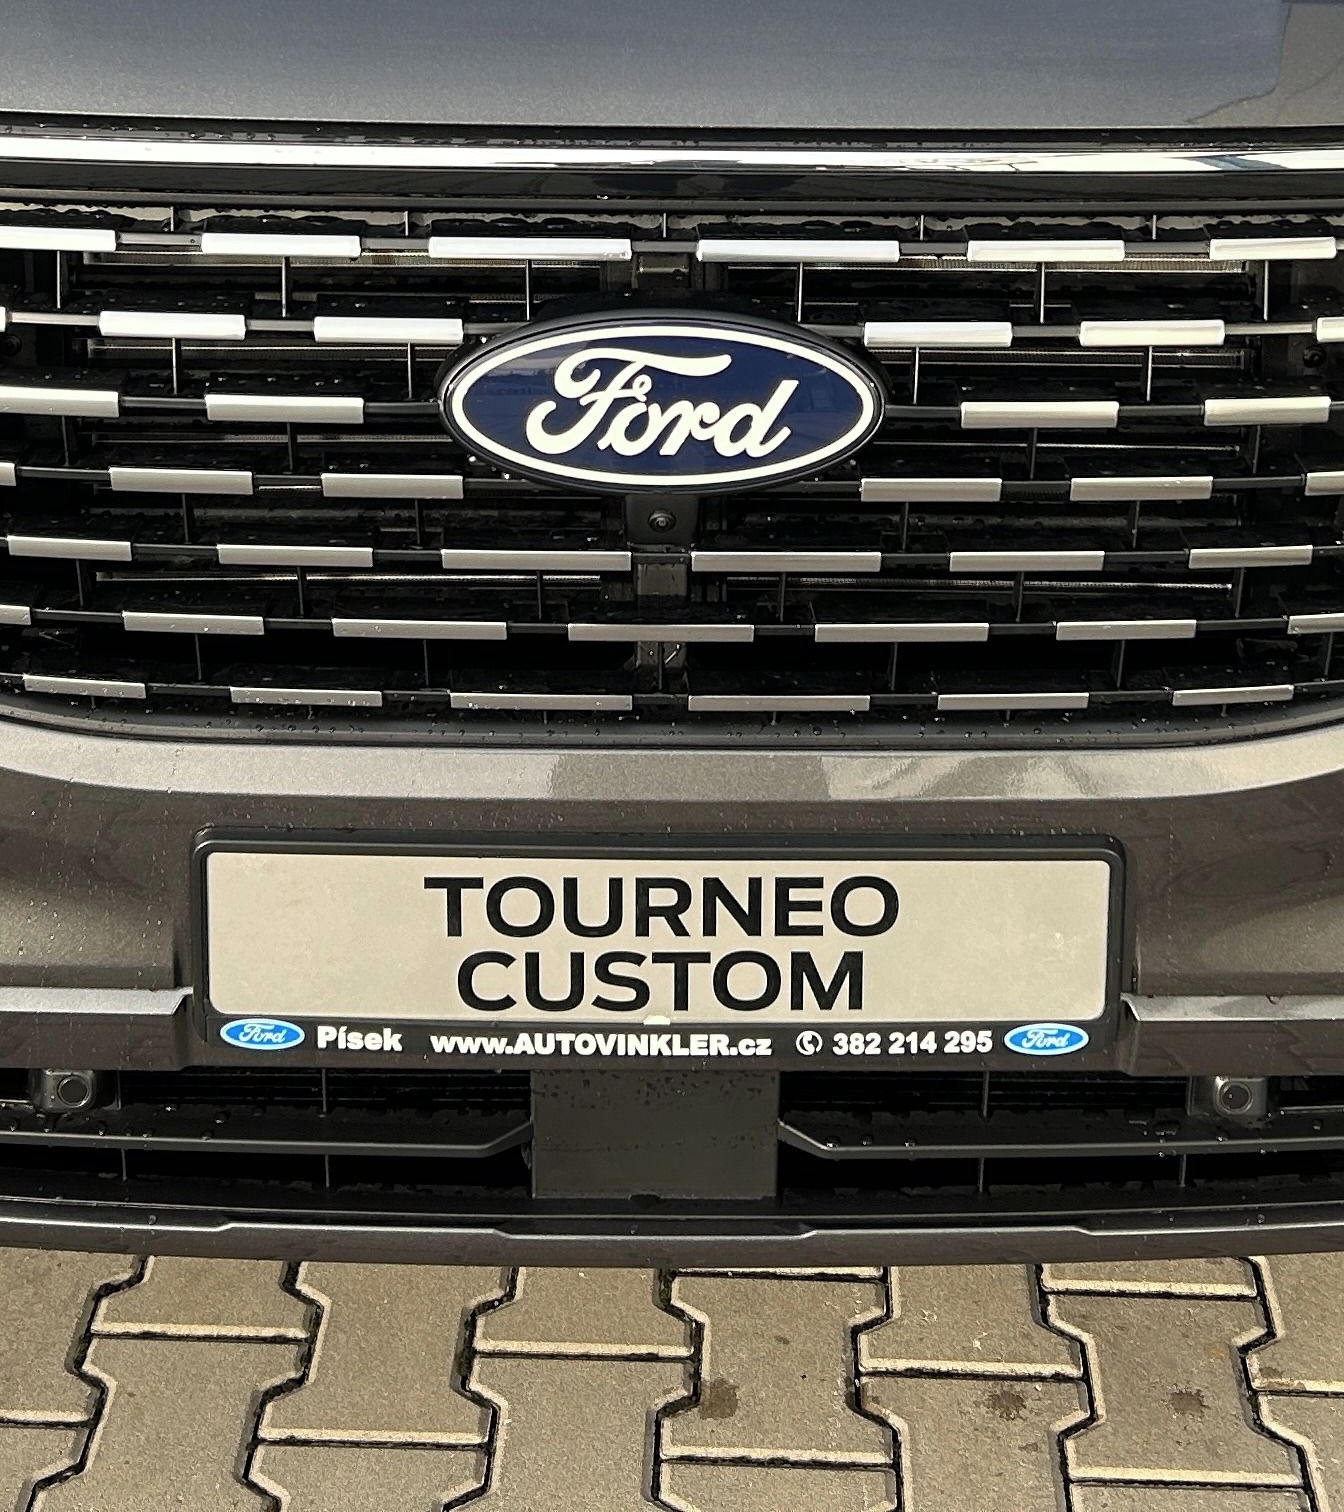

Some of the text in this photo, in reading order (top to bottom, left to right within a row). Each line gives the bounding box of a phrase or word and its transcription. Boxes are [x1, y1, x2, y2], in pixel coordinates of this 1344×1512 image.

[525, 348, 799, 458] Ford
[424, 876, 900, 939] TOURNEO
[458, 951, 865, 1013] CUSTOM
[317, 1026, 994, 1057] Písek www.AUTOVINKLER.cz 382 214 295
